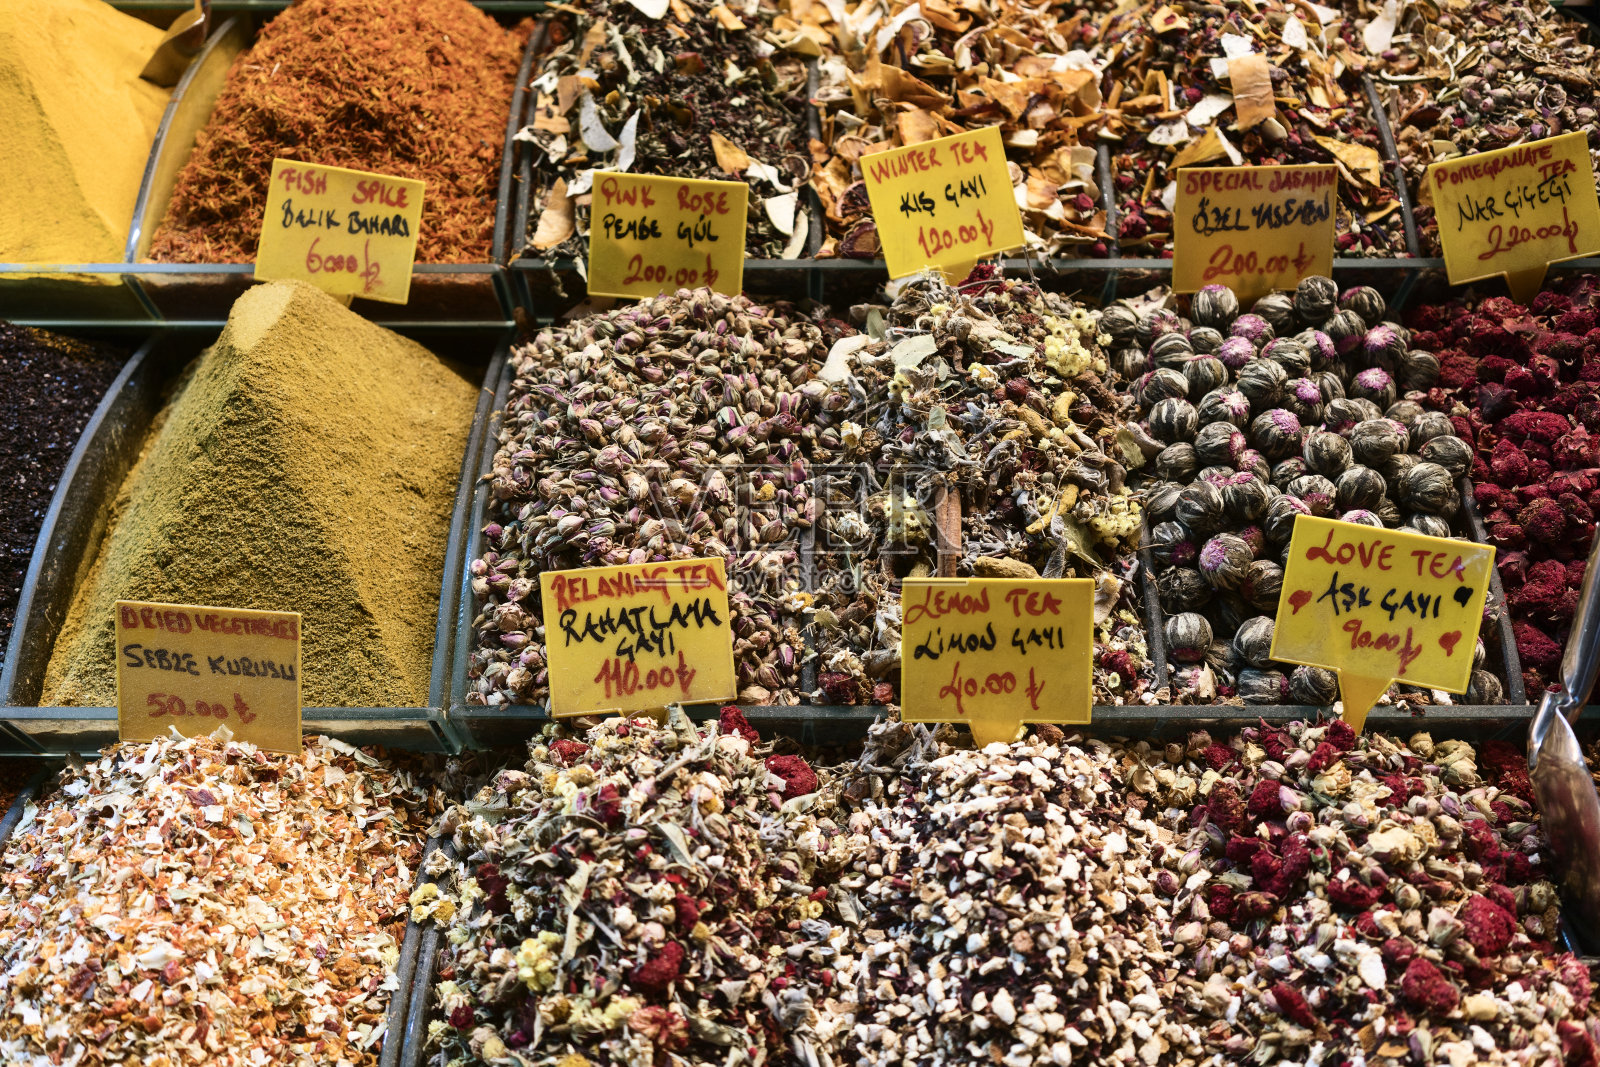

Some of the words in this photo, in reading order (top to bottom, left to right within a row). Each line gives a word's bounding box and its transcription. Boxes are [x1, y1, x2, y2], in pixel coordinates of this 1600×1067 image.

[869, 147, 942, 184] WINTER
[950, 141, 988, 166] TEA
[1434, 145, 1553, 190] POMEGRANATE
[1538, 159, 1577, 182] TEA
[278, 168, 327, 195] FISH
[352, 180, 409, 208] SPICE
[601, 177, 656, 208] PINK
[677, 185, 730, 215] ROSE
[1185, 171, 1263, 195] SPECIAL
[603, 213, 662, 240] PEMBE
[1458, 194, 1504, 231] NAR
[1306, 528, 1396, 570] LOVE
[1411, 550, 1466, 582] TEA
[550, 567, 671, 613] RELAXING
[673, 564, 725, 593] TEA
[904, 586, 990, 625] LEMON
[1005, 588, 1063, 617] TEA
[121, 606, 192, 634] DRIED
[207, 655, 297, 681] KURUSU
